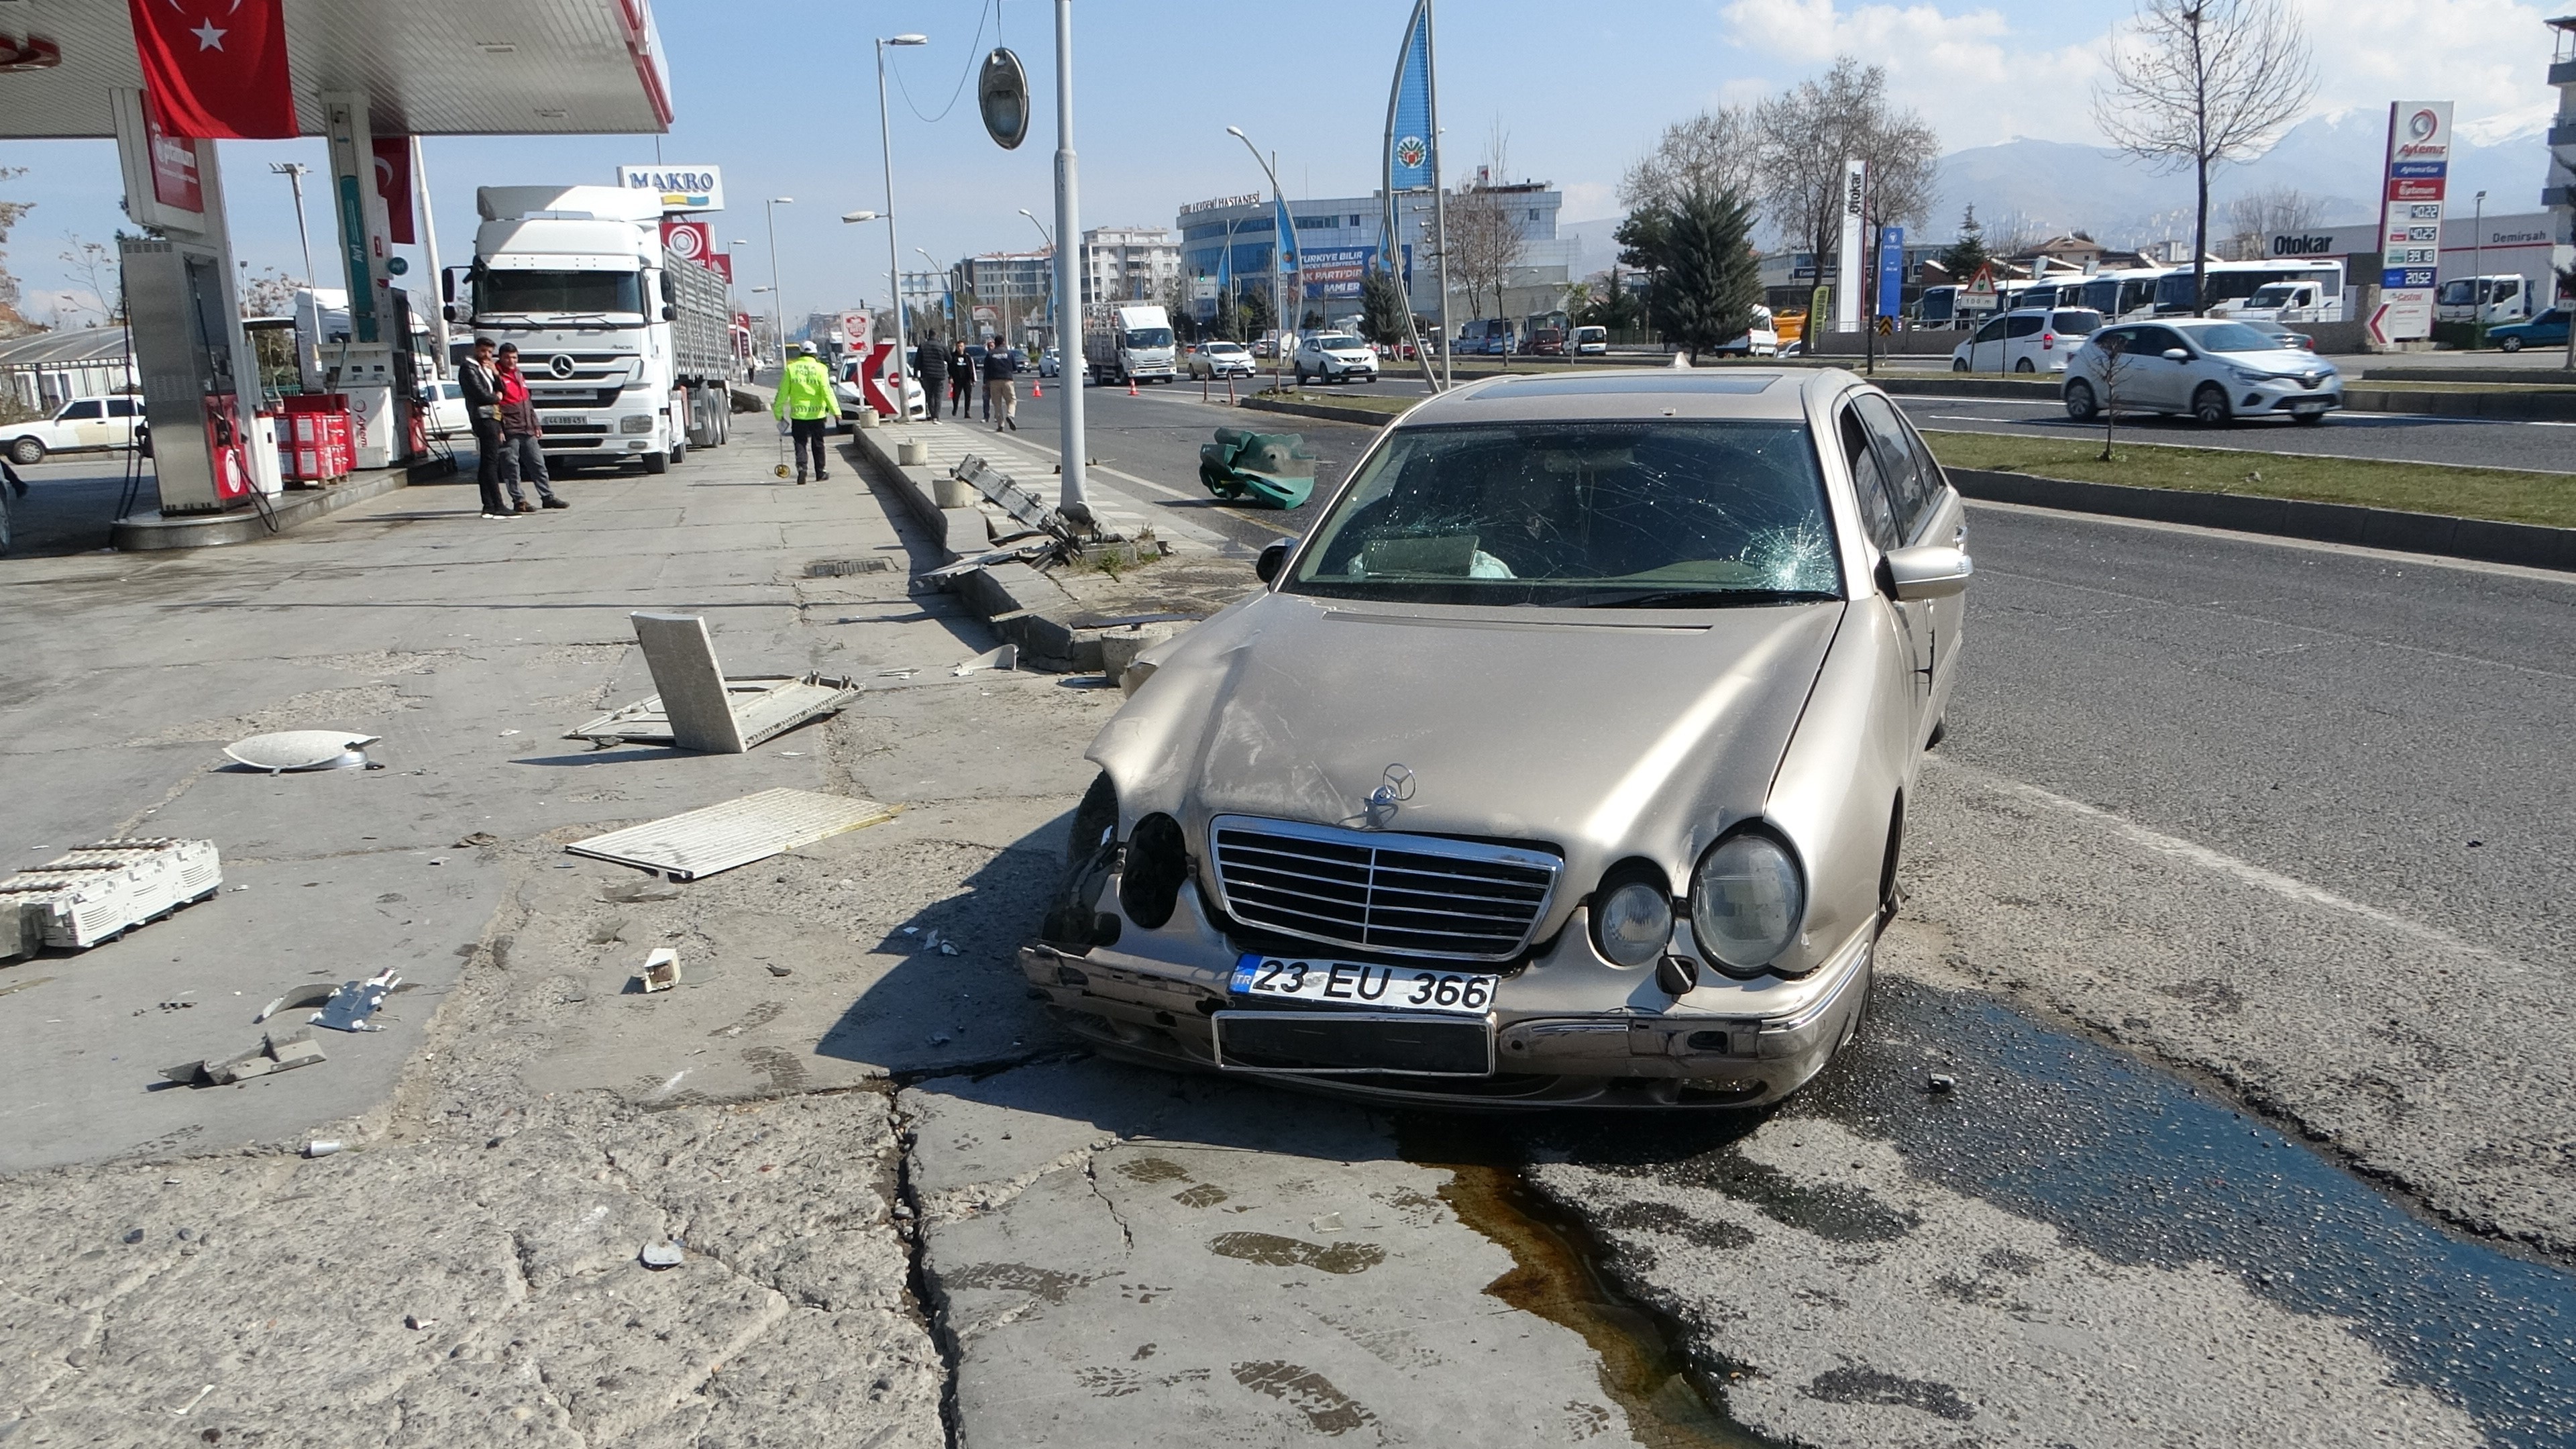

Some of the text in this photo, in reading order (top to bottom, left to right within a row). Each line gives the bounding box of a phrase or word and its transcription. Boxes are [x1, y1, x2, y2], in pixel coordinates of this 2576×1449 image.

[2398, 143, 2447, 156] Aytemiz
[629, 172, 714, 193] MAKRO
[1849, 171, 1862, 213] Otokar
[1218, 191, 1260, 209] HASTANESİ
[2273, 234, 2333, 256] Otokar
[1347, 282, 1360, 291] ER
[1236, 973, 1250, 985] TR
[1252, 960, 1491, 1008] 23 EU 366
